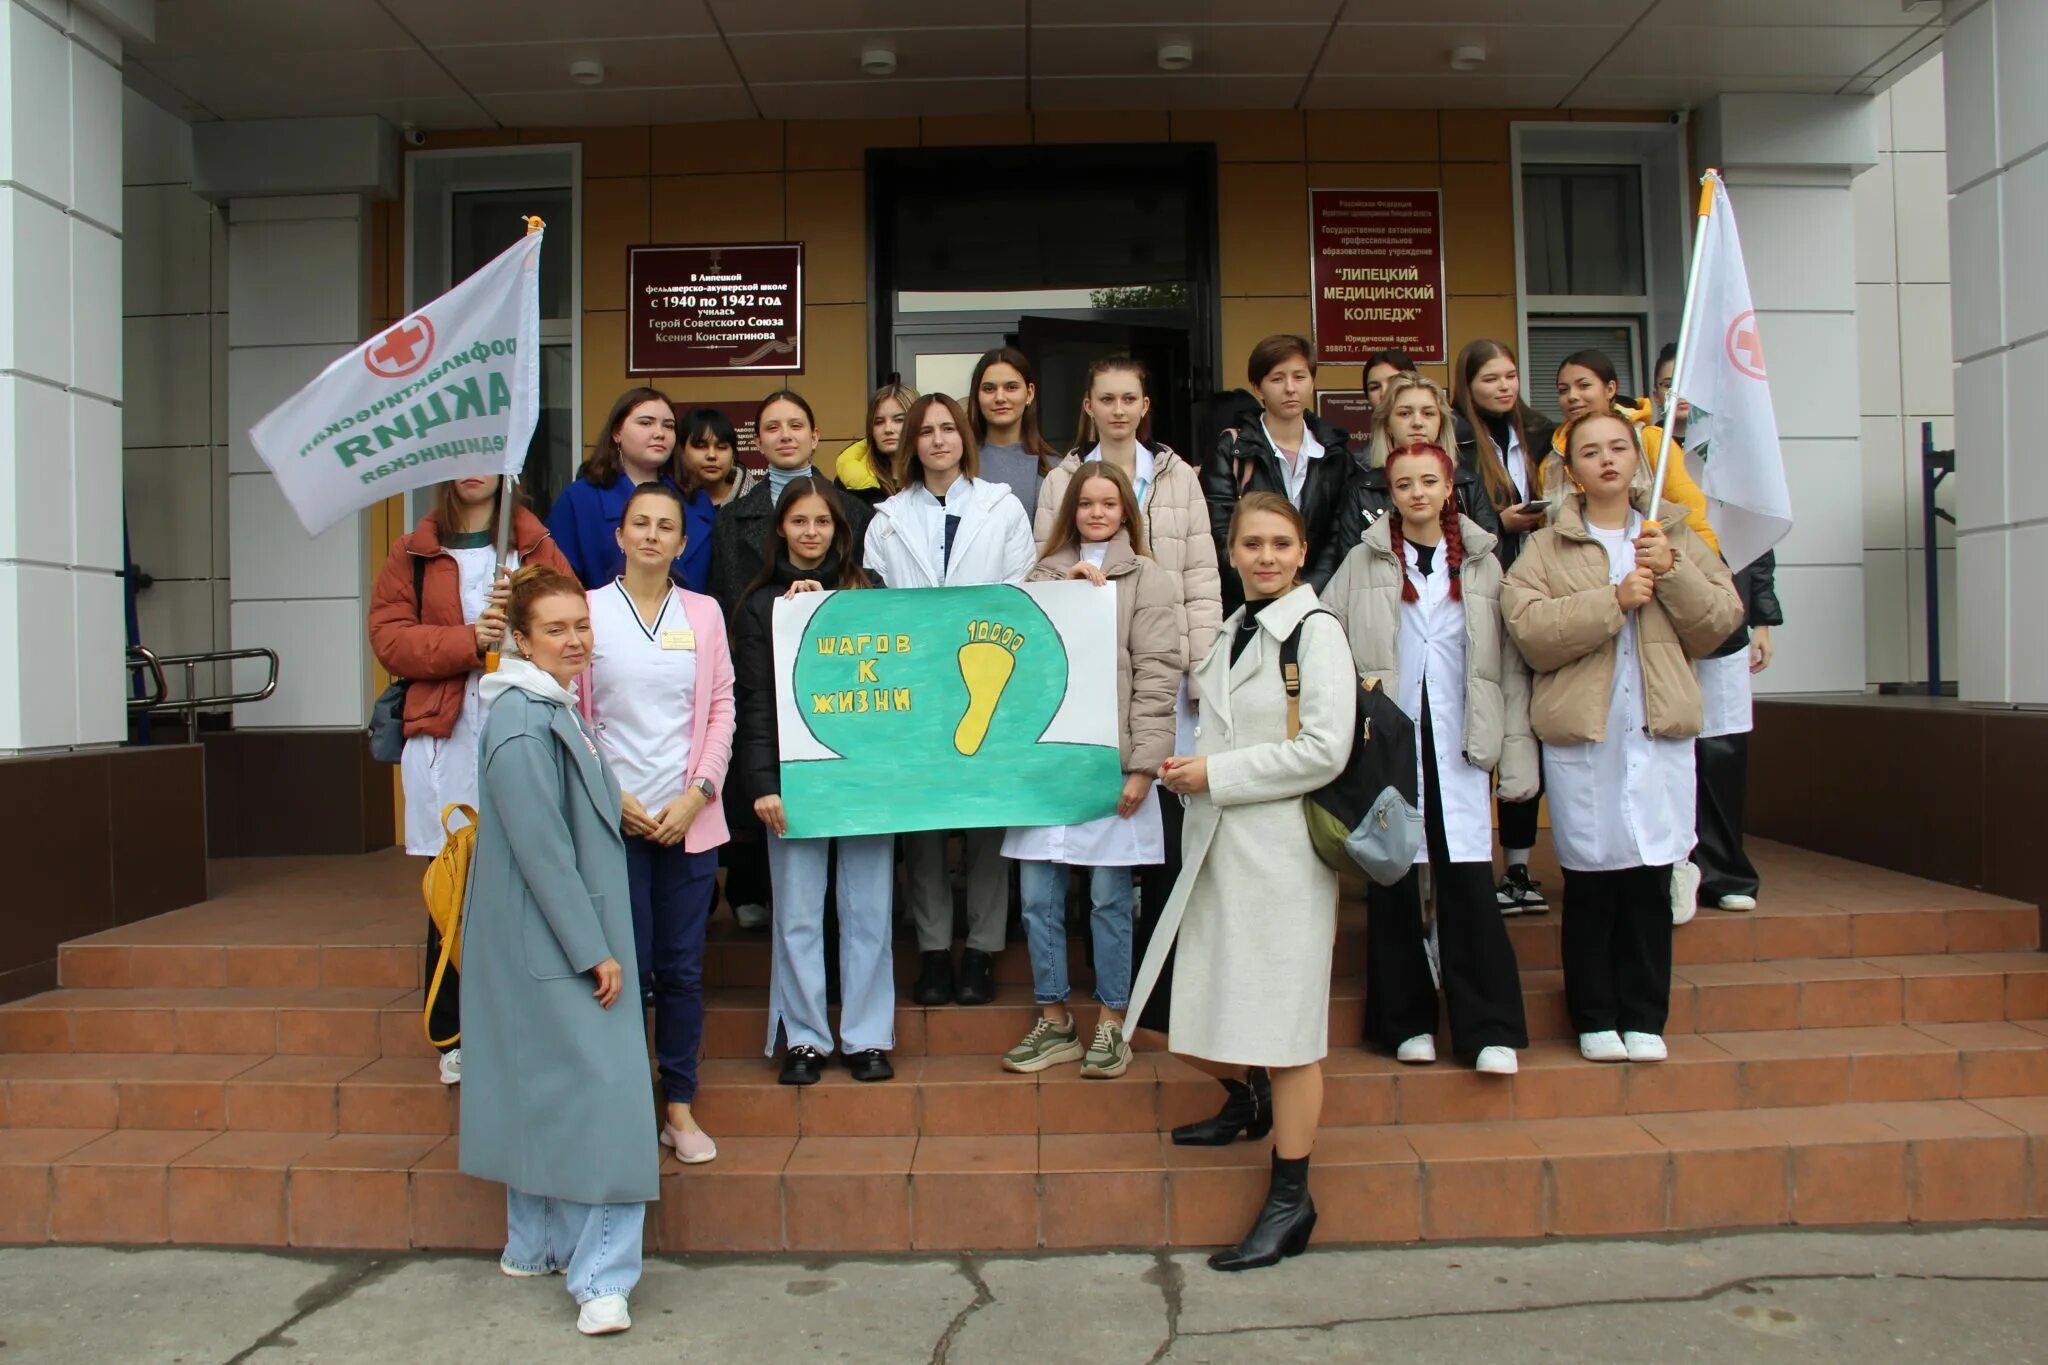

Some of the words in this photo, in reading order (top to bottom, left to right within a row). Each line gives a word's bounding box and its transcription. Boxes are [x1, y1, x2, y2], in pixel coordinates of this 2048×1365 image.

[1322, 225, 1386, 235] Государственное
[1387, 226, 1432, 234] автономное
[1341, 237, 1413, 245] профессиональное
[1322, 247, 1387, 256] образовательное
[1389, 248, 1433, 256] учреждение
[691, 274, 697, 282] В
[698, 273, 742, 282] Липецкой
[645, 283, 758, 295] фельдшерско-акушерской
[760, 283, 788, 291] школе
[1324, 284, 1434, 301] МЕДИЦИНСКИЙ
[651, 299, 659, 308] с
[663, 296, 696, 308] 1940
[699, 298, 717, 307] по
[721, 295, 755, 307] 1942
[758, 296, 782, 306] год
[697, 308, 735, 318] училась
[649, 318, 681, 331] Герой
[683, 317, 746, 328] Советского
[748, 316, 784, 327] Союза
[656, 333, 693, 342] Ксения
[695, 331, 776, 342] Константинова
[1345, 335, 1394, 343] Юридический
[968, 620, 1025, 652] 10000
[816, 634, 912, 655] ШАГОВ
[858, 657, 879, 683] К
[811, 687, 912, 714] ЖИЗНИ
